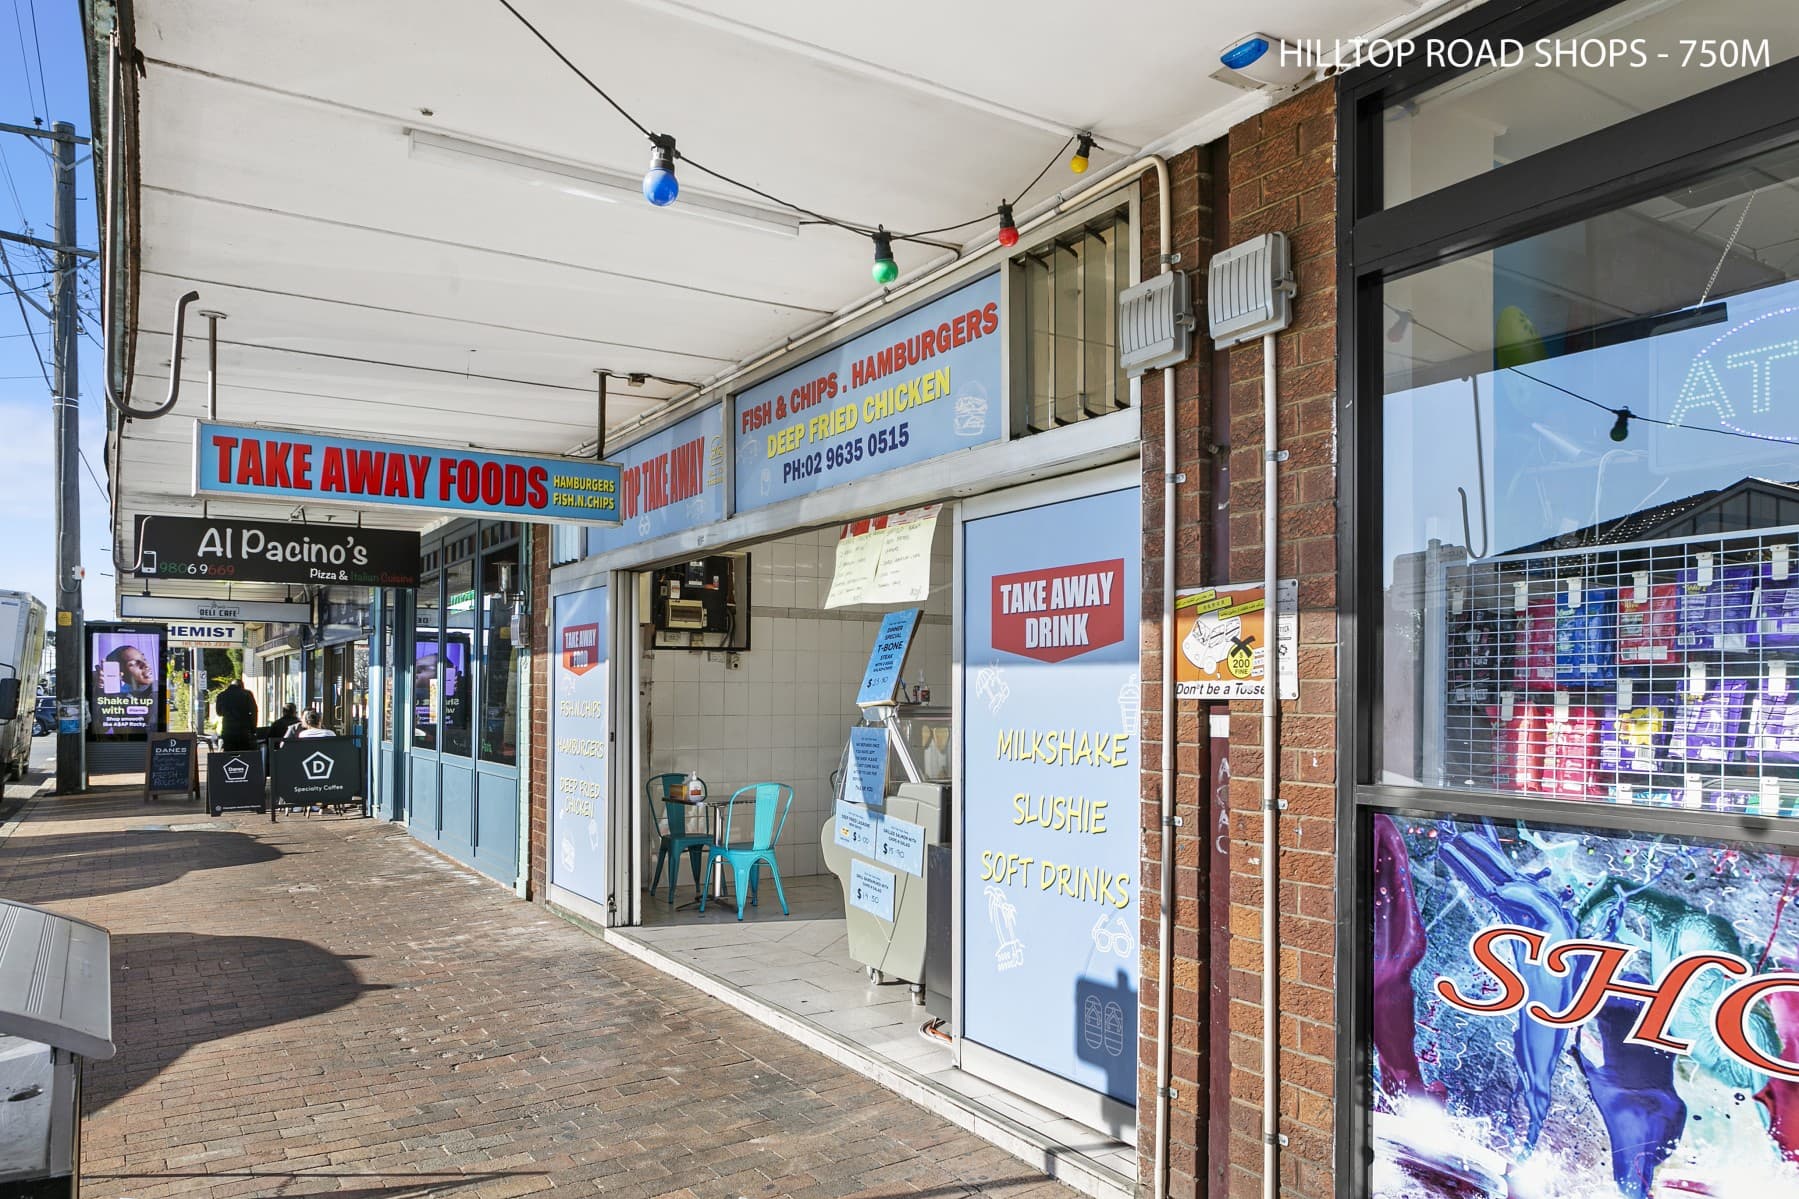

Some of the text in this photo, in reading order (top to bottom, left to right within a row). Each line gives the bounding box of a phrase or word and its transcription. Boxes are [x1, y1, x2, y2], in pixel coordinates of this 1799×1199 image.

[742, 400, 772, 434] FISH
[775, 395, 787, 420] &
[789, 372, 838, 413] CHIPS
[851, 302, 999, 389] HAMBURGERS
[767, 366, 951, 459] DEEP FRIED CHICKEN
[783, 422, 910, 484] PH:02 9635 0515
[213, 435, 549, 509] TAKE AWAY FOODS
[553, 474, 615, 493] HAMBURGERS
[642, 453, 668, 513] TAKE
[670, 436, 705, 504] AWAY
[553, 494, 615, 511] FISH.N.CHIPS
[197, 527, 369, 566] Al Pacino's
[309, 567, 337, 581] Pizza
[339, 570, 348, 580] &
[1000, 571, 1114, 615] TAKE AWAY
[199, 609, 237, 617] DELI CAFE
[1025, 613, 1089, 649] DRINK
[565, 628, 597, 649] TAKE AWAY
[878, 641, 904, 653] T-BONE
[1232, 659, 1250, 669] 200
[97, 696, 130, 705] Shake
[141, 698, 153, 707] up
[1206, 683, 1220, 695] be
[1223, 686, 1230, 695] a
[101, 705, 125, 715] with
[996, 728, 1130, 768] MILKSHAKE
[1013, 792, 1108, 834] SLUSHIE
[980, 850, 1131, 910] SOFT DRINKS
